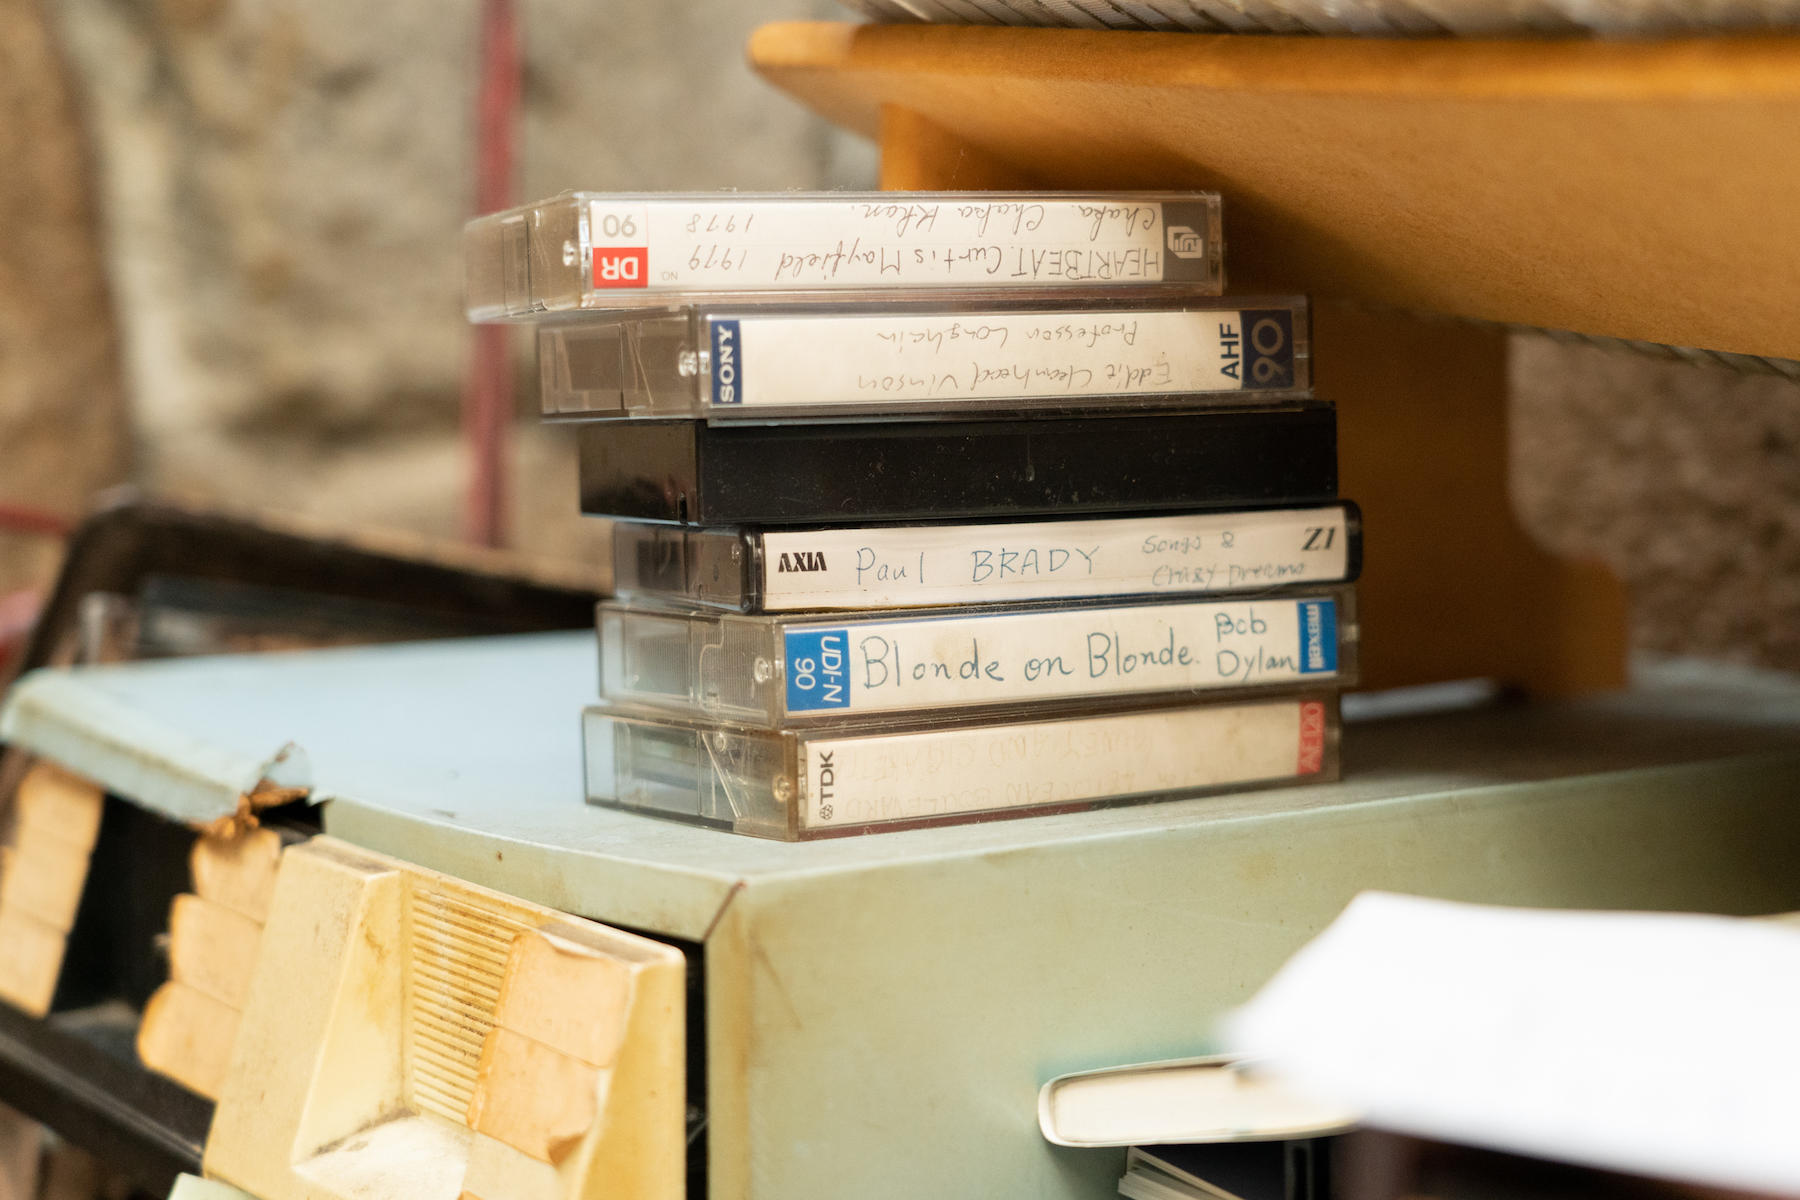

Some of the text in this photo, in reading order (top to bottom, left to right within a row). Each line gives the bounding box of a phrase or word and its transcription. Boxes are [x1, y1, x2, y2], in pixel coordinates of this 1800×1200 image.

[602, 213, 638, 239] 90
[686, 212, 755, 234] 1978
[961, 203, 1045, 238] Chaka
[601, 256, 640, 281] DR
[688, 243, 748, 271] 1979
[774, 237, 900, 281] Mayfield
[915, 245, 1001, 275] Curtis
[717, 324, 736, 403] SONY
[1219, 322, 1240, 380] AHF
[1251, 317, 1284, 384] 90
[857, 374, 960, 396] Vinson
[1104, 359, 1173, 392] Eddie
[1141, 531, 1235, 556] Songs &
[1301, 526, 1336, 551] Z1
[777, 551, 828, 574] AXIA
[856, 545, 1100, 585] Paul BRADY
[1213, 607, 1268, 643] Bob
[794, 657, 817, 691] 90
[819, 635, 843, 703] UDI-N
[860, 635, 1004, 690] Blonde
[1024, 656, 1075, 682] on
[1215, 646, 1298, 682] Dylan
[819, 750, 834, 805] TDK
